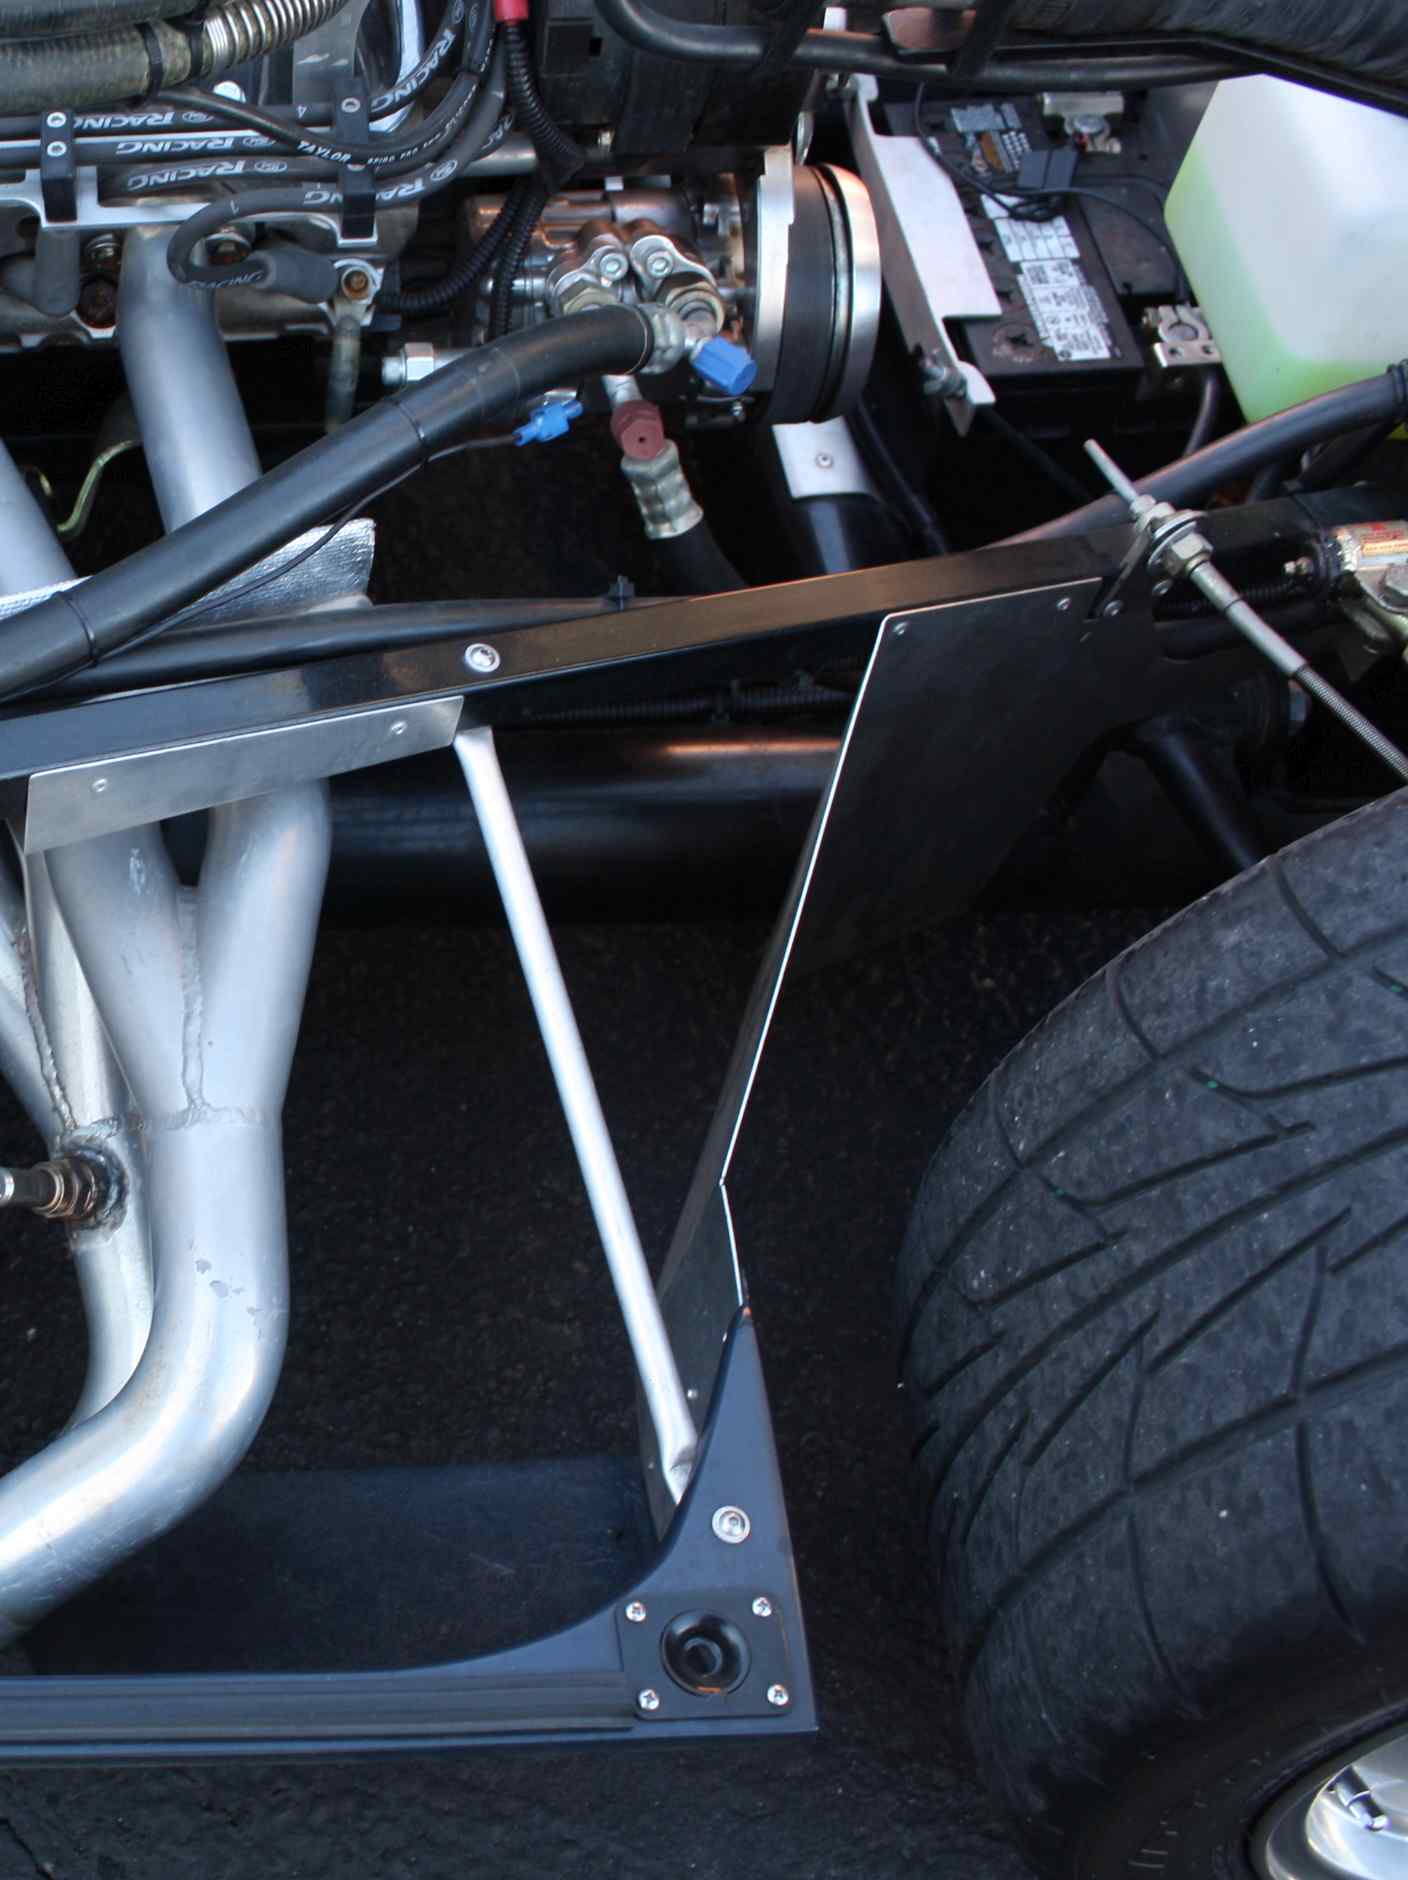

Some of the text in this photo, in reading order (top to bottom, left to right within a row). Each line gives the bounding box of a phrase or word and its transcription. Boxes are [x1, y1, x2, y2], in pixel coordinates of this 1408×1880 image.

[297, 105, 307, 118] 4
[115, 138, 235, 156] RACING
[296, 140, 353, 164] TAYLOR
[127, 158, 246, 190] RACING
